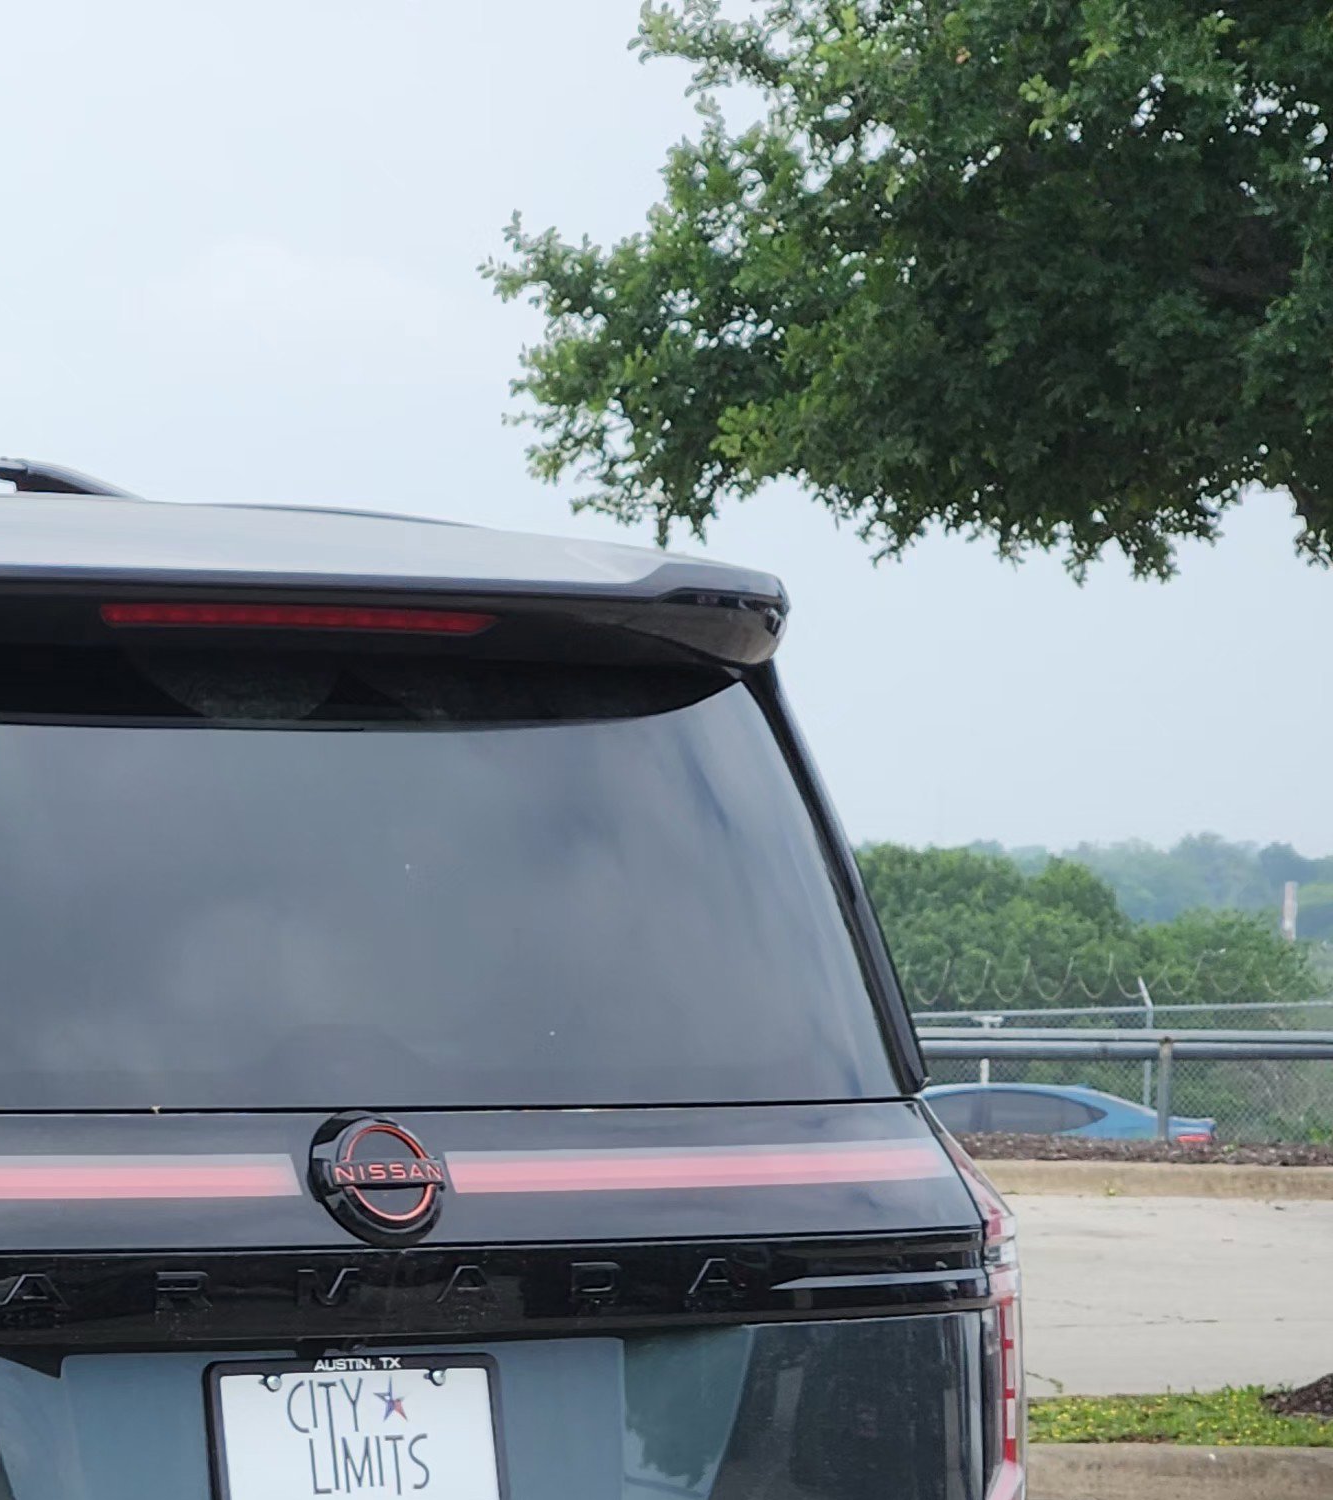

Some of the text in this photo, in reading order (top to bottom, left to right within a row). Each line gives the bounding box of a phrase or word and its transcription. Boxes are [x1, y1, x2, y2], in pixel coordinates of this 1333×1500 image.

[334, 1163, 445, 1183] NISSAN
[378, 1356, 402, 1369] TX
[286, 1377, 363, 1434] CITY
[308, 1432, 430, 1496] LIMITS
